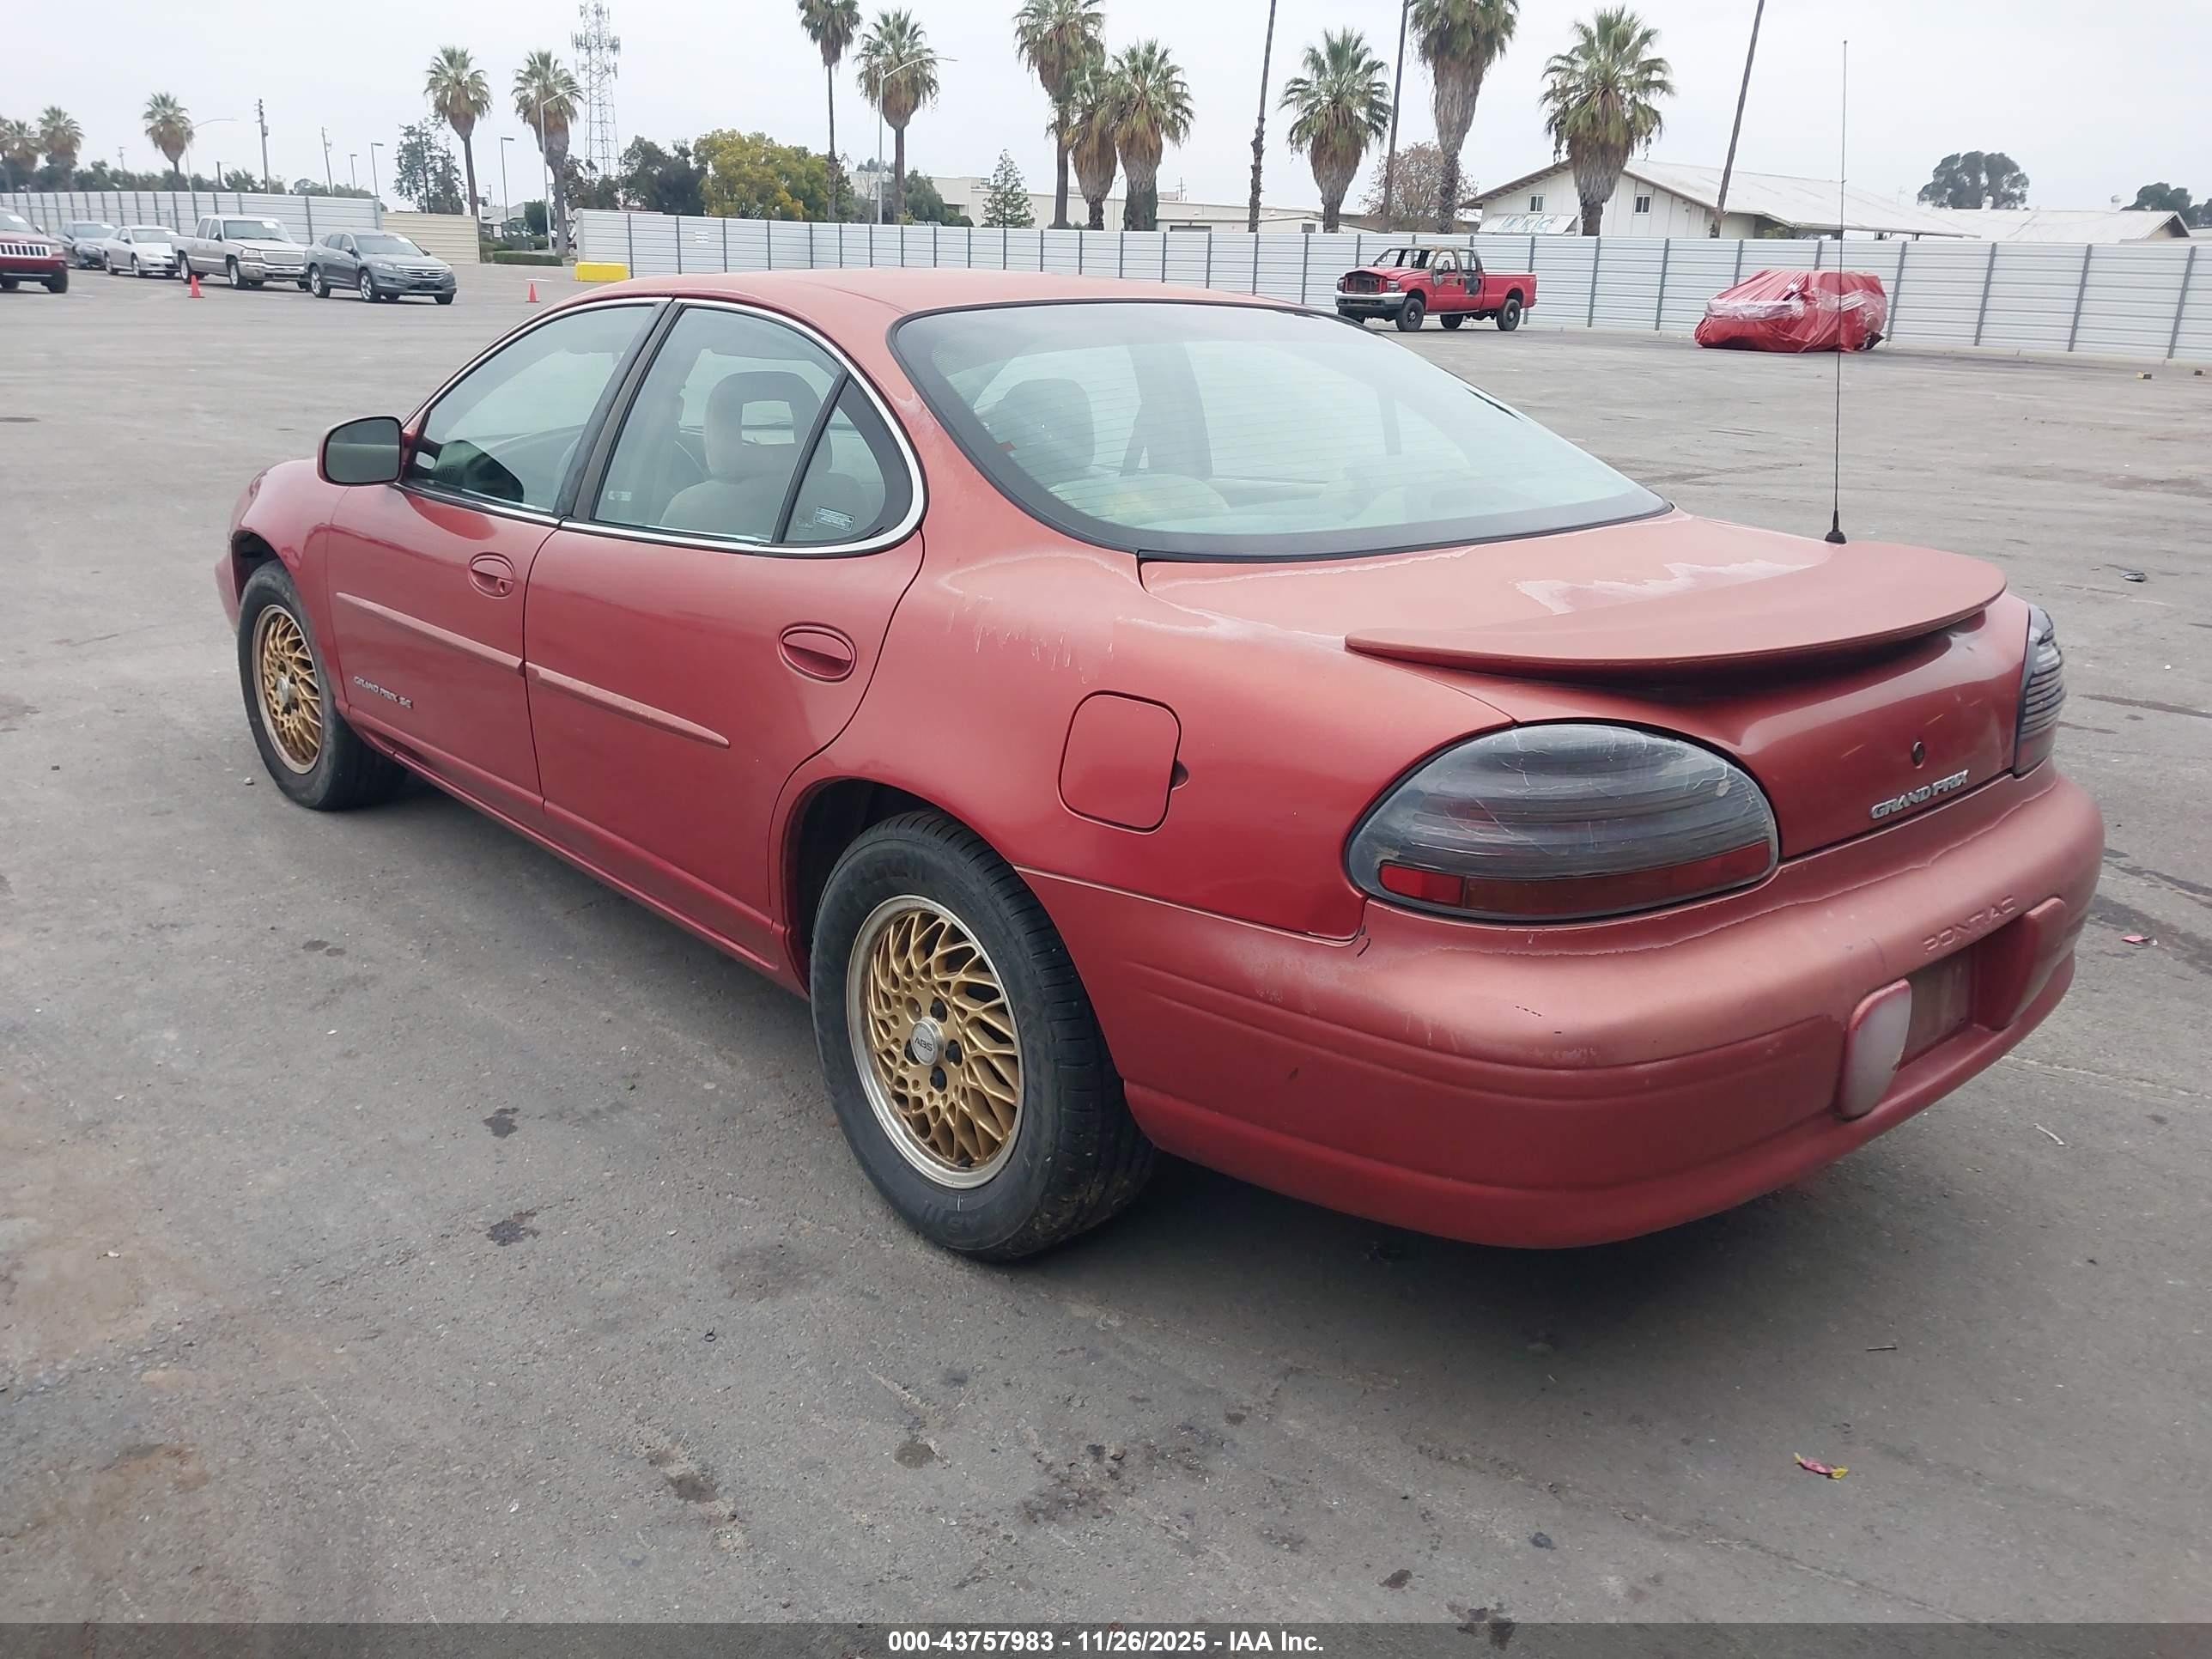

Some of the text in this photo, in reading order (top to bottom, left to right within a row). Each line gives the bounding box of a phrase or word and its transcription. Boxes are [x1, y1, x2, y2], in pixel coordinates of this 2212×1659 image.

[1871, 769, 1969, 819] GRAND PRIX
[1923, 896, 2016, 956] PONTIAC
[915, 1036, 933, 1052] ABS
